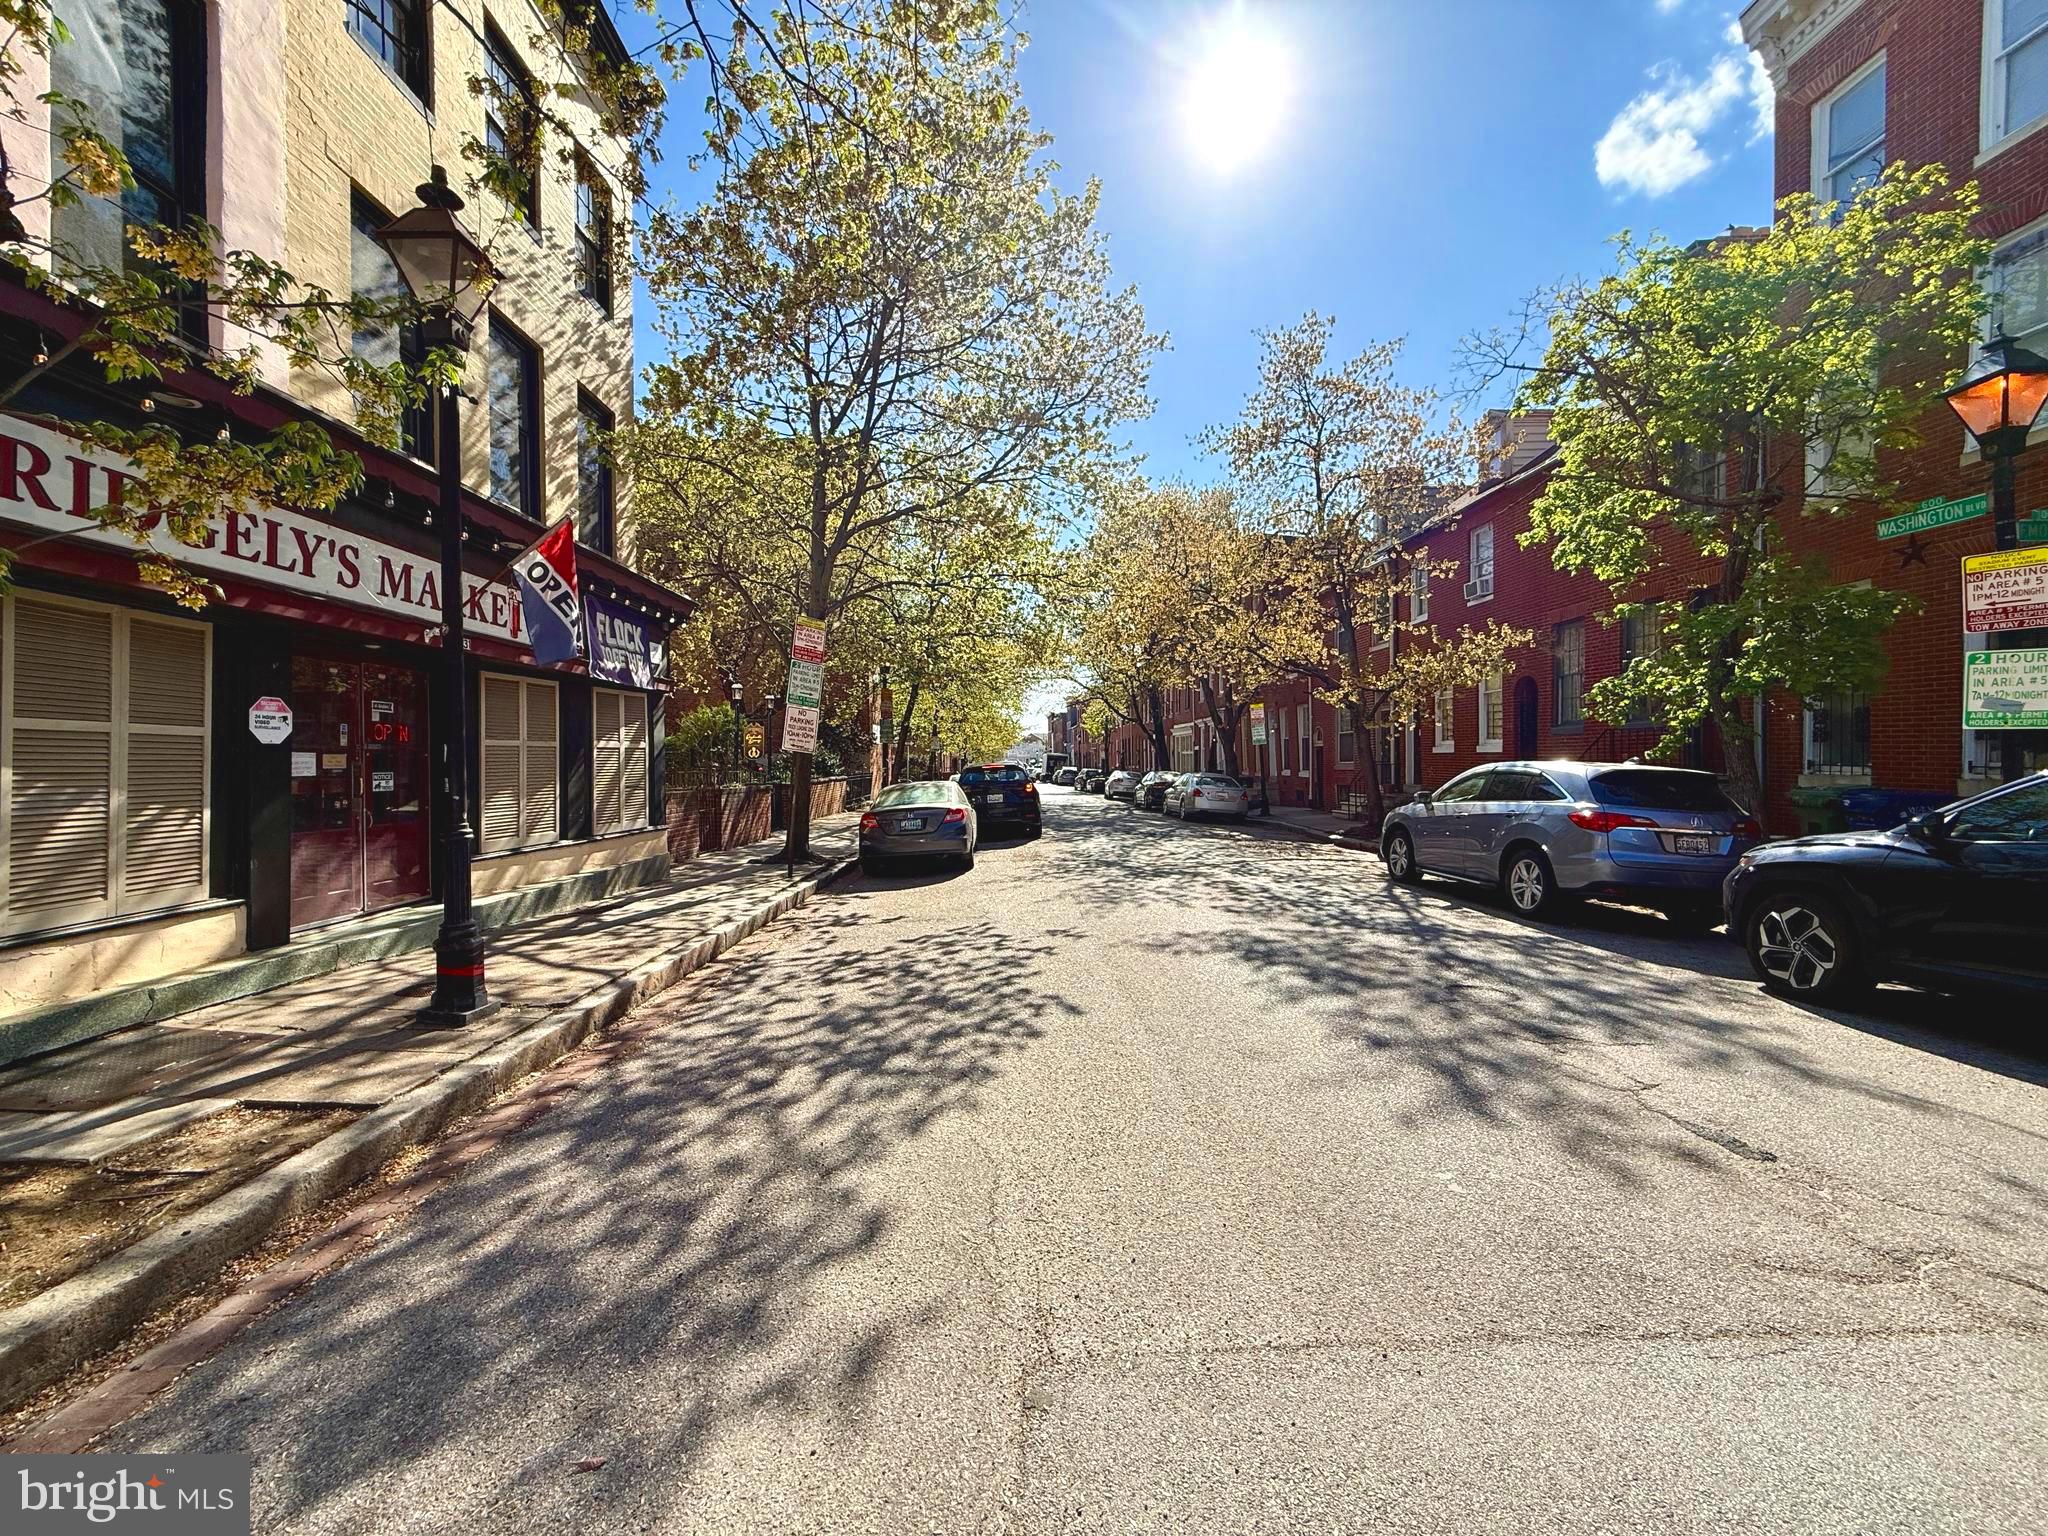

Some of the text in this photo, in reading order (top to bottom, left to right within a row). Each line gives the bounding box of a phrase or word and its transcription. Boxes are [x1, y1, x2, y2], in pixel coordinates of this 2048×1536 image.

[1921, 497, 1942, 509] 600
[1877, 501, 1986, 537] WASHINGTON BLVD
[1978, 554, 2037, 566] STADIUM EVENT
[1966, 565, 2048, 582] NO PARKING
[1968, 563, 2012, 572] RESTRICTED
[1973, 583, 1983, 592] IN
[1988, 580, 2019, 589] AREA
[376, 554, 523, 634] MAKE
[1972, 587, 2045, 601] 1PM-12 MIDNIGHT
[1969, 609, 1994, 617] AREA
[2016, 603, 2048, 612] PERMIT
[1970, 610, 2048, 622] HOLDERS EXCEPTED
[1971, 617, 2048, 631] TOW AWAY ZONE
[596, 611, 645, 655] FLOCK
[1975, 652, 2047, 664] 2 HOUR
[1972, 664, 2048, 675] PARKING LIMIT
[1973, 678, 1985, 687] IN
[1991, 677, 2024, 687] AREA
[790, 716, 814, 726] PARKING
[375, 723, 409, 742] OPN
